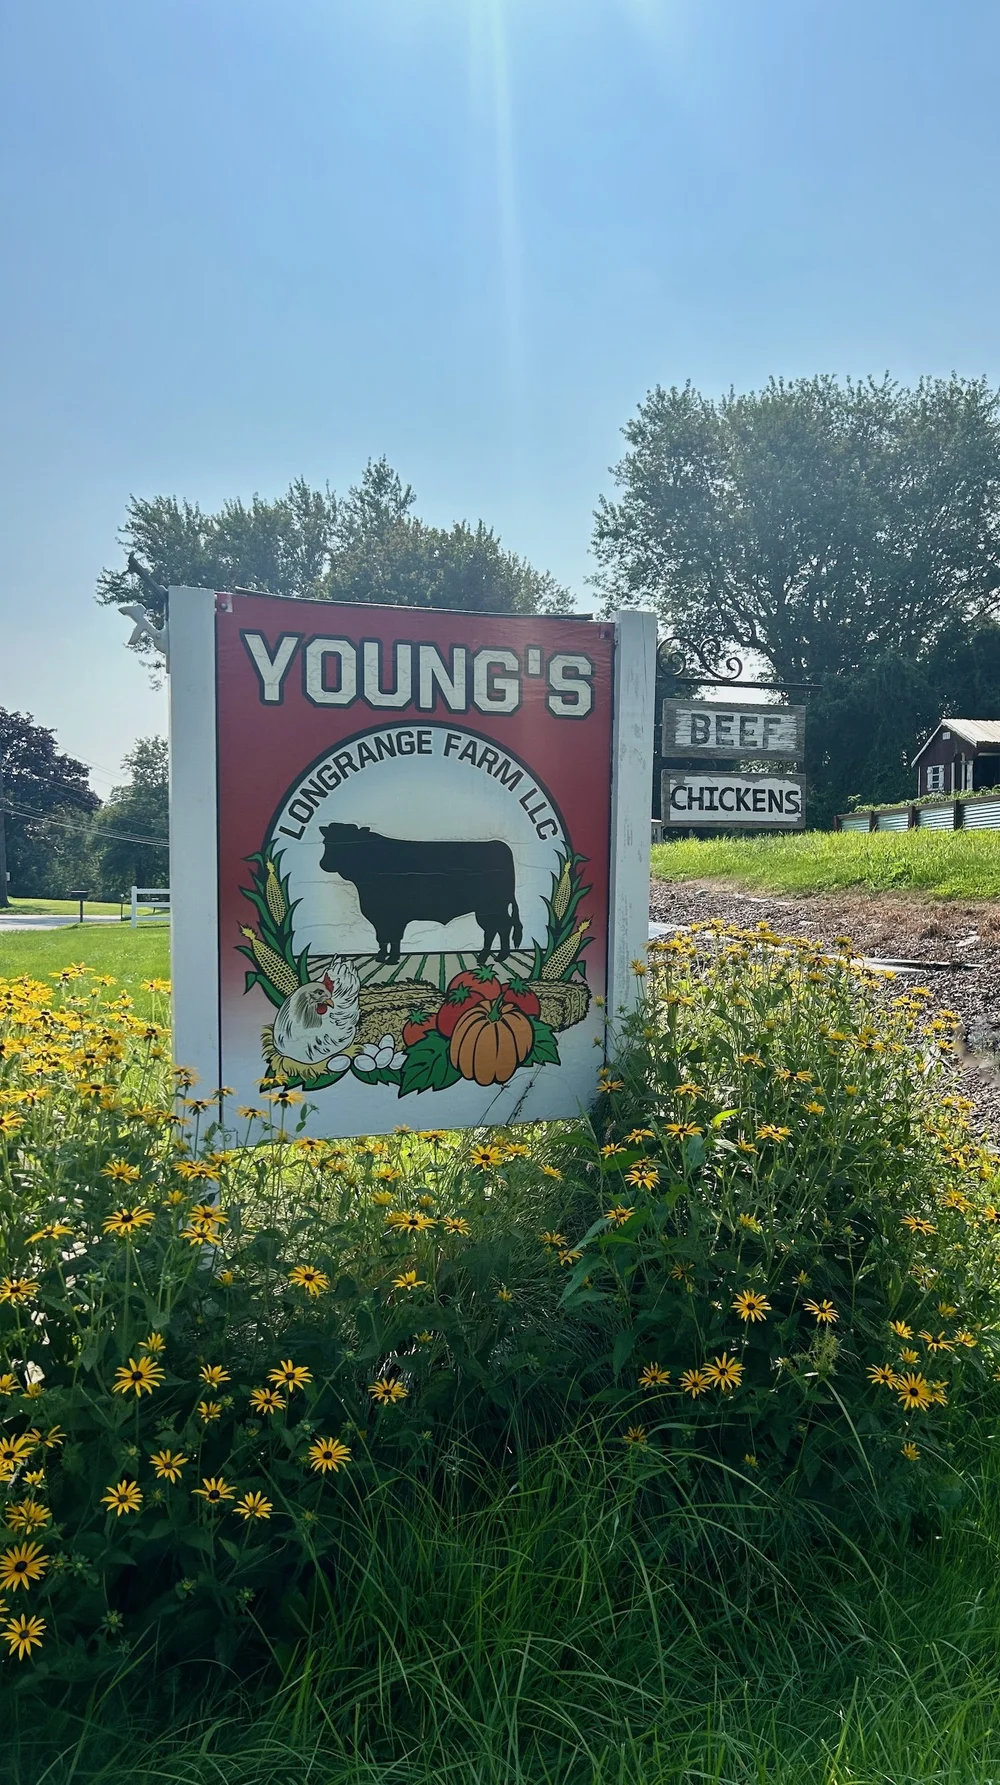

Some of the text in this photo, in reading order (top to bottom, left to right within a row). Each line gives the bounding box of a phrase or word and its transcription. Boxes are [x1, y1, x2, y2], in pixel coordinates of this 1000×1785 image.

[241, 630, 594, 719] YOUNG'S
[690, 713, 782, 749] BEEF
[278, 730, 559, 841] LONGRANGE FARM LLC
[671, 785, 801, 814] CHICKENS
